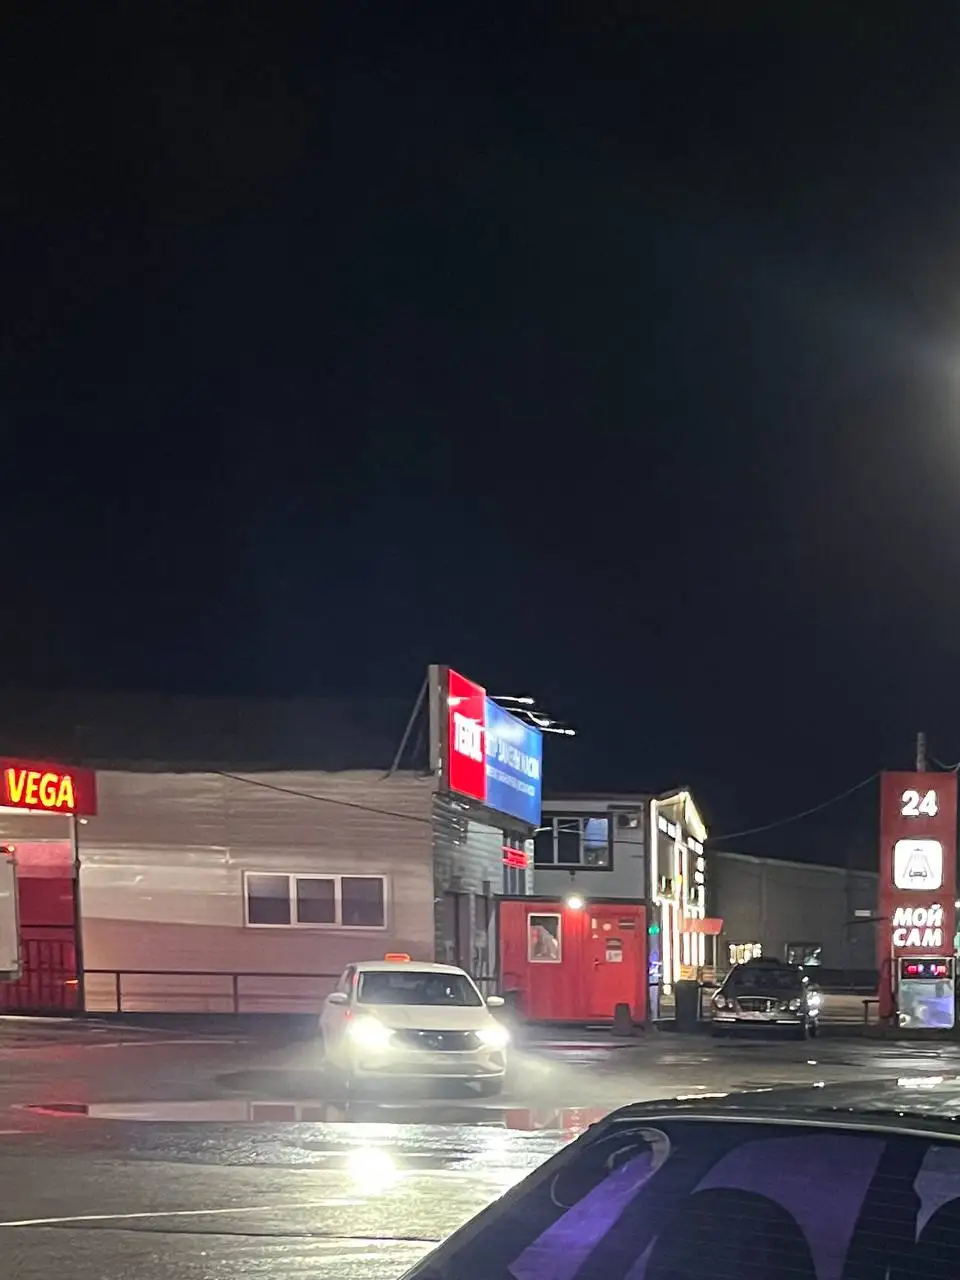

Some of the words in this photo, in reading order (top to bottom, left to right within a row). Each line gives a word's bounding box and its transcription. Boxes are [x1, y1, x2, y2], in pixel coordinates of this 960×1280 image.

[5, 768, 76, 809] VEGA
[901, 789, 939, 817] 24
[893, 904, 944, 927] МОЙ
[893, 928, 943, 947] САМ
